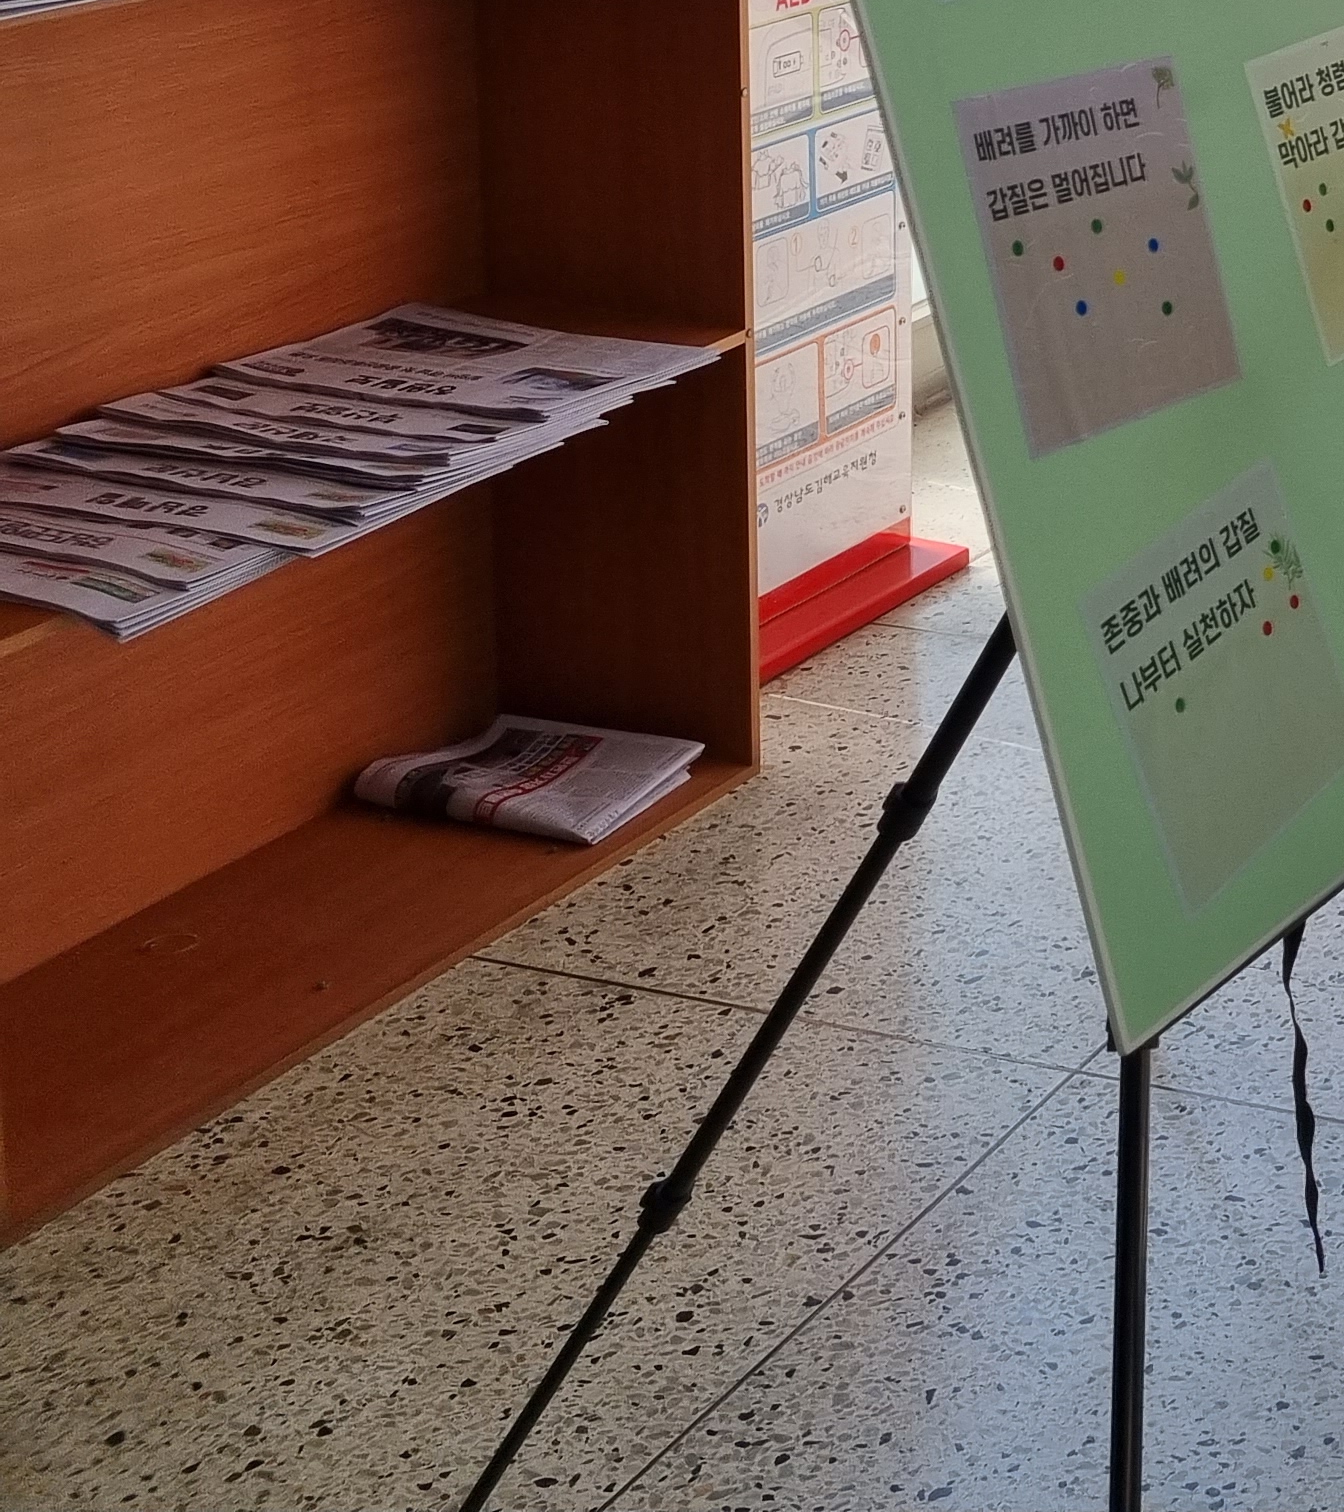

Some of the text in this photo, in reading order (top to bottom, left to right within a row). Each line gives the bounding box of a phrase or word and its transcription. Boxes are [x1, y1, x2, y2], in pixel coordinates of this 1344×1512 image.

[973, 97, 1140, 164] 배려를 가까이 하면
[1263, 75, 1314, 119] 불어라
[1277, 127, 1329, 169] 막아라
[987, 152, 1146, 222] 갑질은 멀어집니다
[774, 450, 877, 513] 경상남도김해교육지원청
[1101, 508, 1260, 656] 존중과 배려의 갑질
[1120, 579, 1258, 712] 나부터 실천하자
